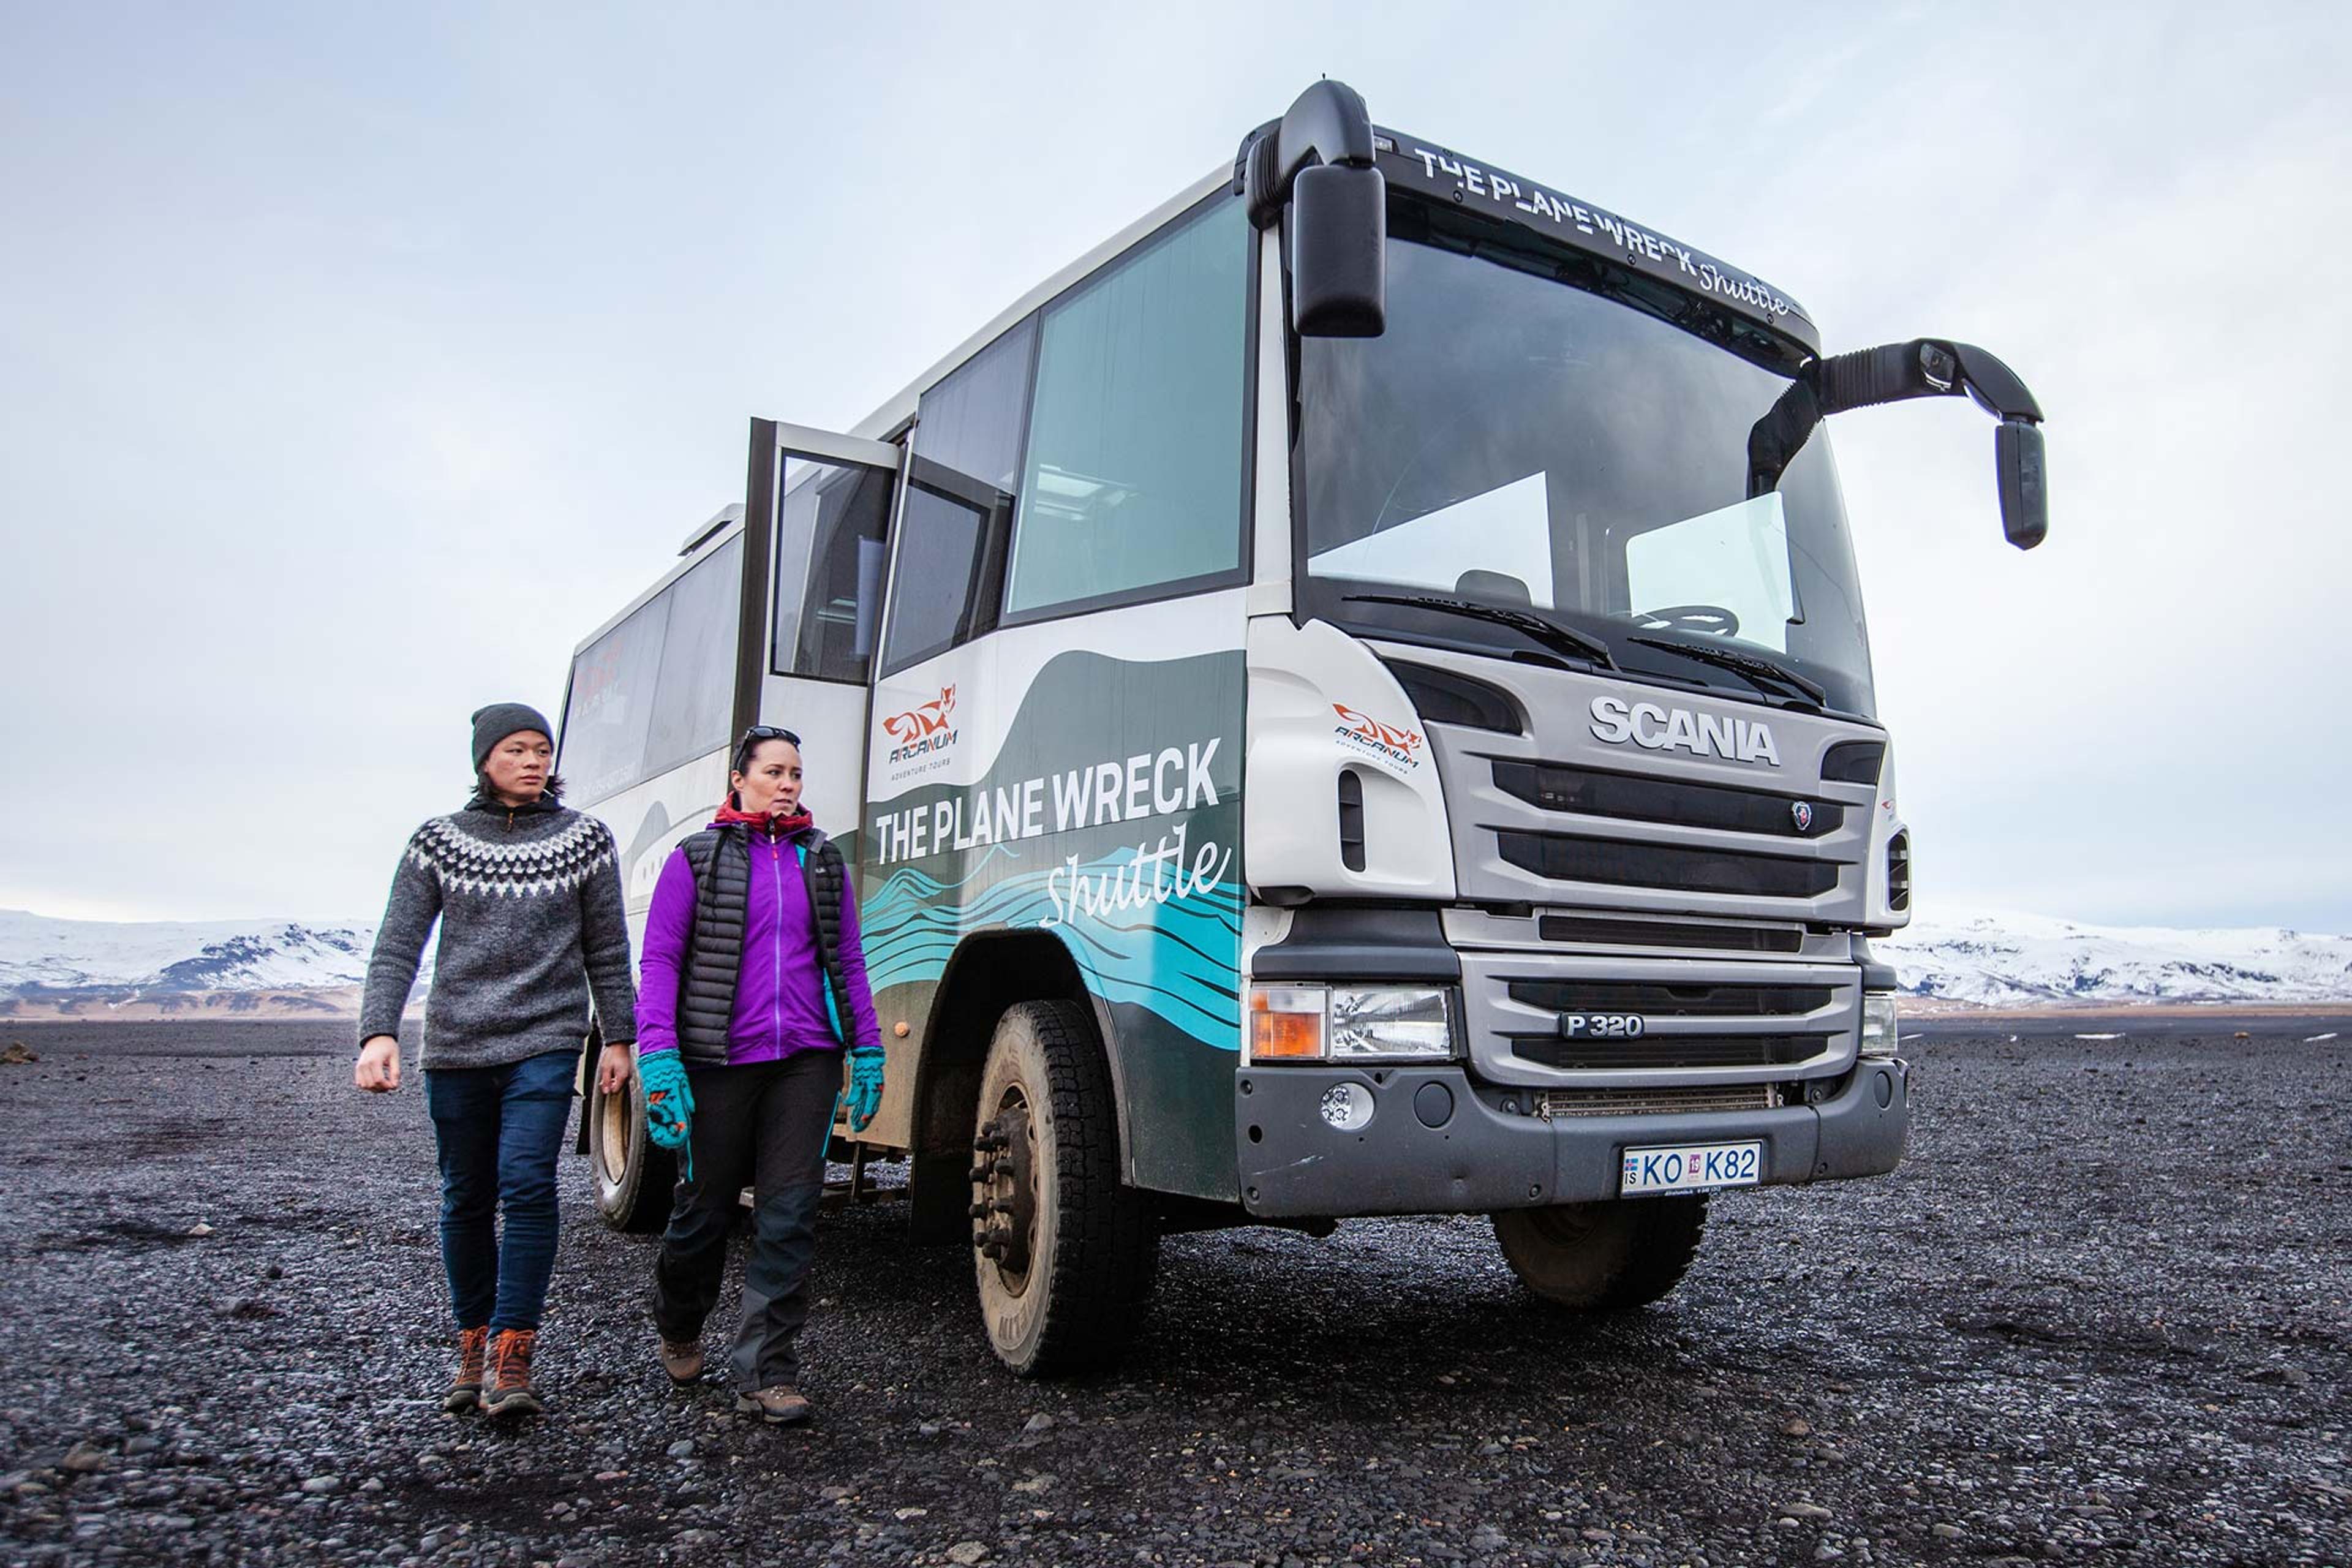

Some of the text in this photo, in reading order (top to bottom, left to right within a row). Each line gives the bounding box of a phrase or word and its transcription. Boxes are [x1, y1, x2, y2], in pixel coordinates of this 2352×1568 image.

[1414, 148, 1485, 196] THE
[1489, 173, 1593, 235] PLANE
[889, 729, 958, 764] ARCANUM
[1335, 726, 1419, 768] ARCANUM
[1589, 696, 1781, 767] SCANIA
[891, 758, 951, 781] ADVENTURE TOURS
[876, 737, 1221, 865] THE PLANE WRECK
[1567, 1016, 1642, 1036] P 320
[1624, 1172, 1637, 1185] IS
[1643, 1149, 1756, 1185] KO K82
